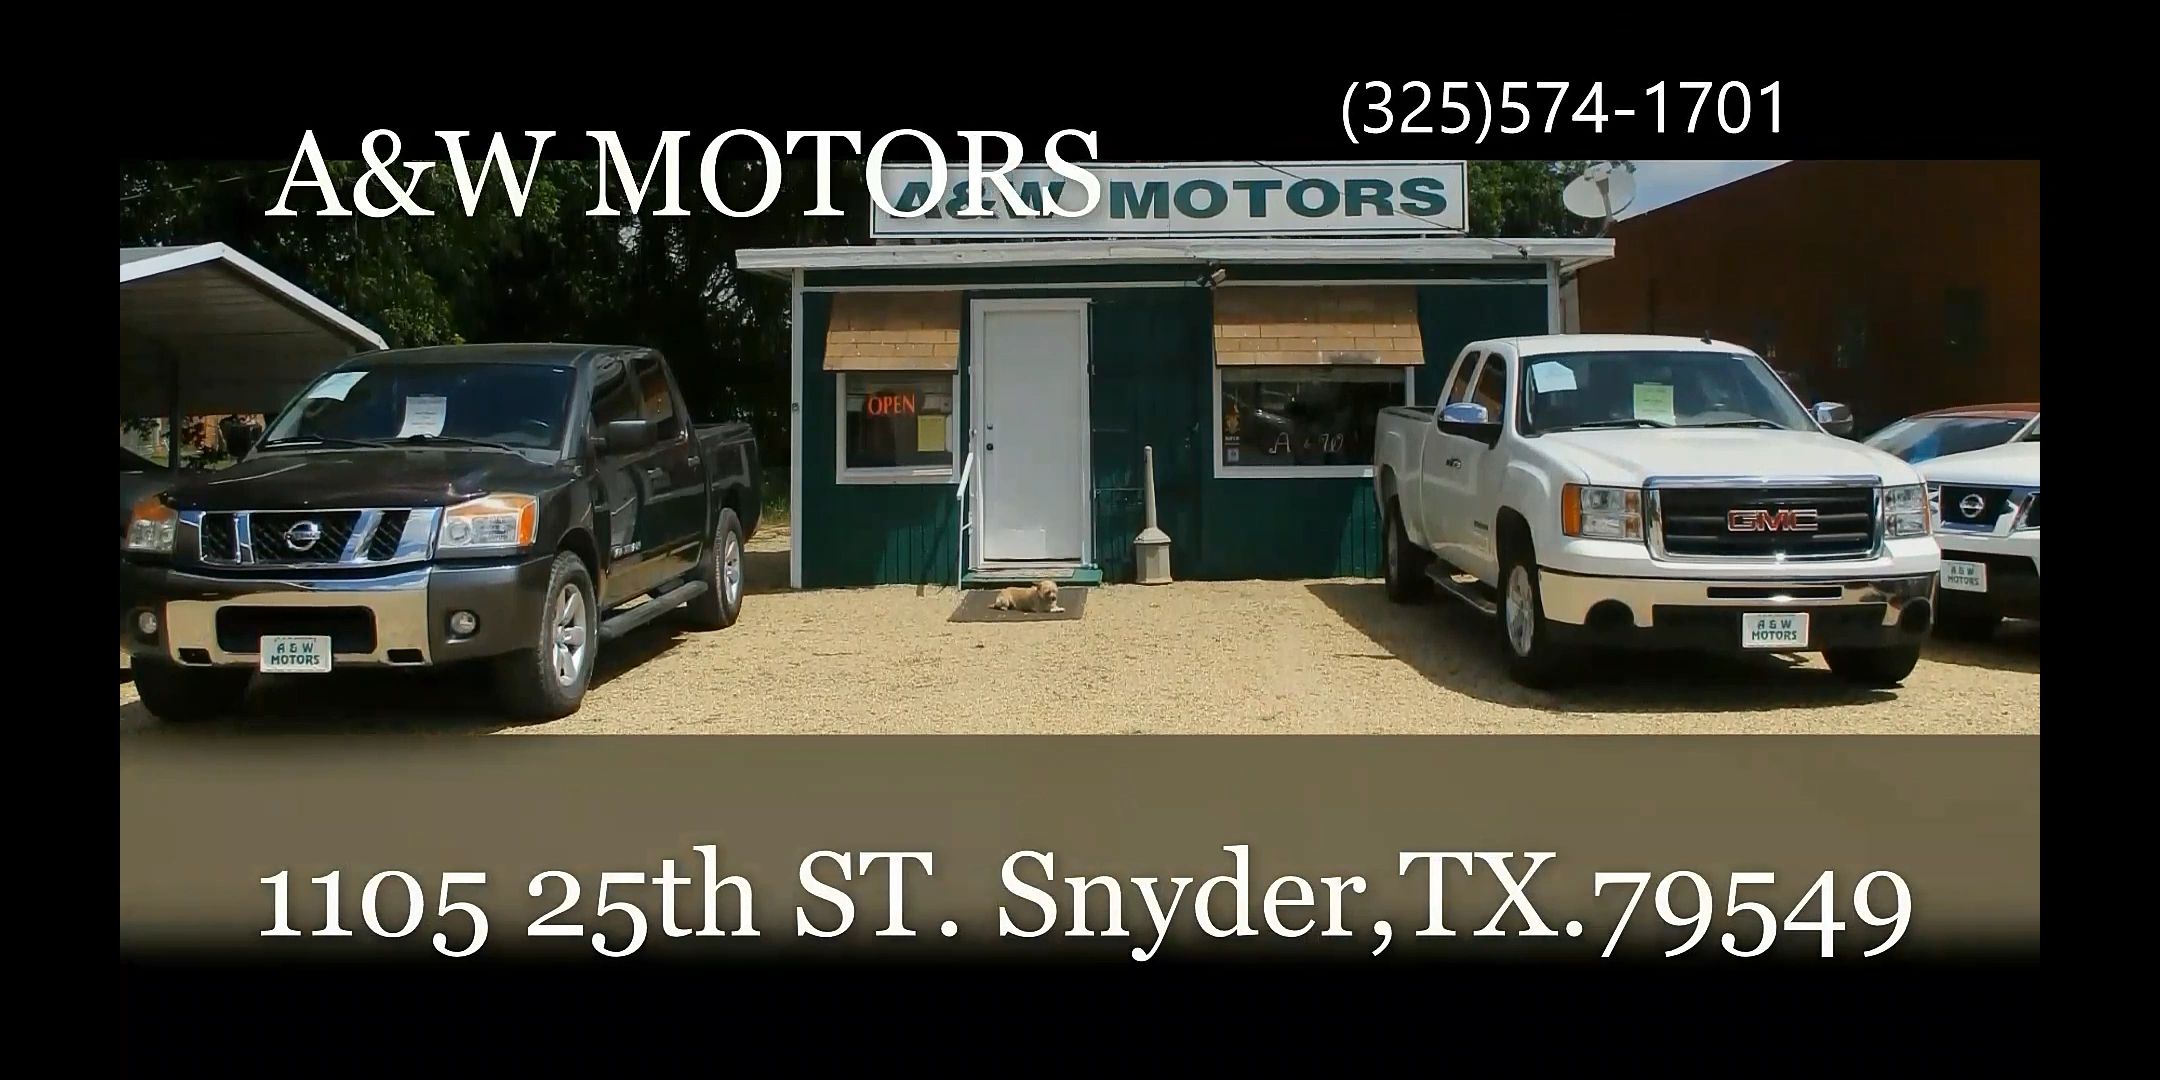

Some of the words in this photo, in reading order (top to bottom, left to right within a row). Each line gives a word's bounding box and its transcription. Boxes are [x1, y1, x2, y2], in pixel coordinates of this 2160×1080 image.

[1109, 178, 1449, 219] MOTORS
[867, 393, 915, 415] OPEN
[1727, 509, 1818, 532] GMC
[1757, 619, 1765, 629] A
[1781, 619, 1792, 630] W
[1752, 631, 1798, 641] MOTORS
[276, 642, 285, 654] A
[302, 642, 314, 654] W
[271, 654, 321, 666] MOTORS
